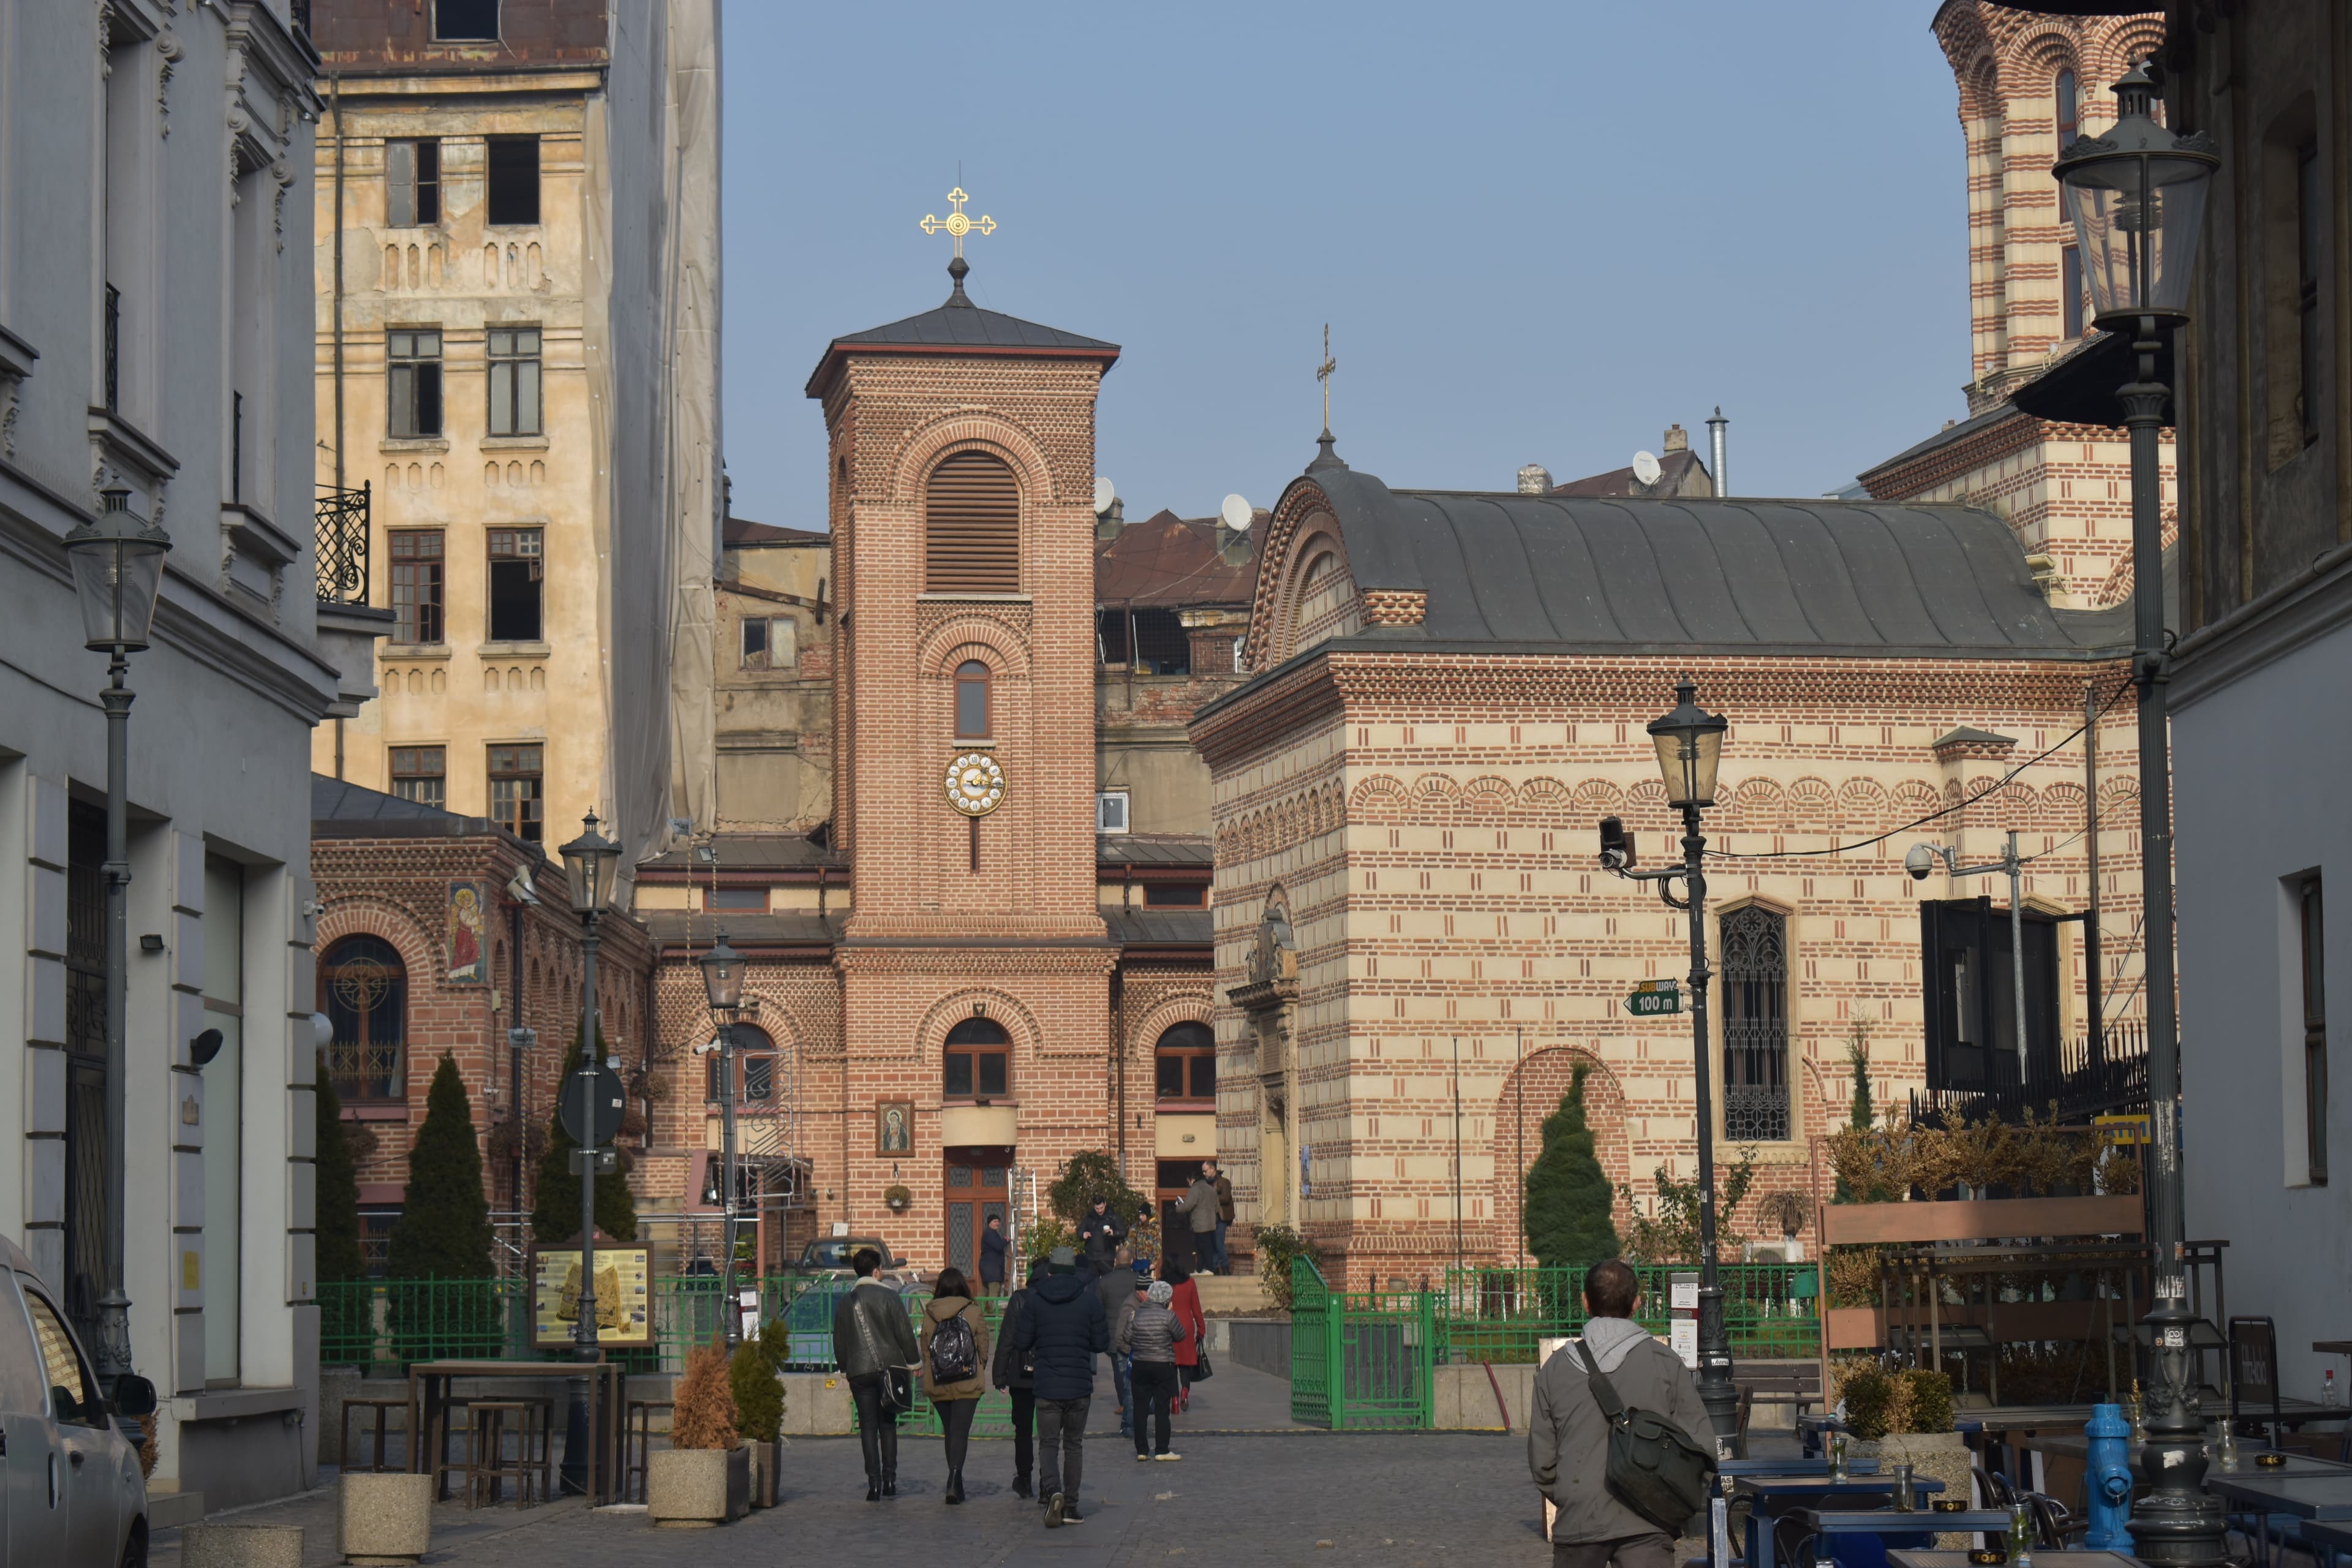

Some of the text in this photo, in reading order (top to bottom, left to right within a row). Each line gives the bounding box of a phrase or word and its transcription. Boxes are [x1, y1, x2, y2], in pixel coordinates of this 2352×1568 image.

[1640, 981, 1676, 992] SUBWAY
[1639, 996, 1673, 1011] 100 m
